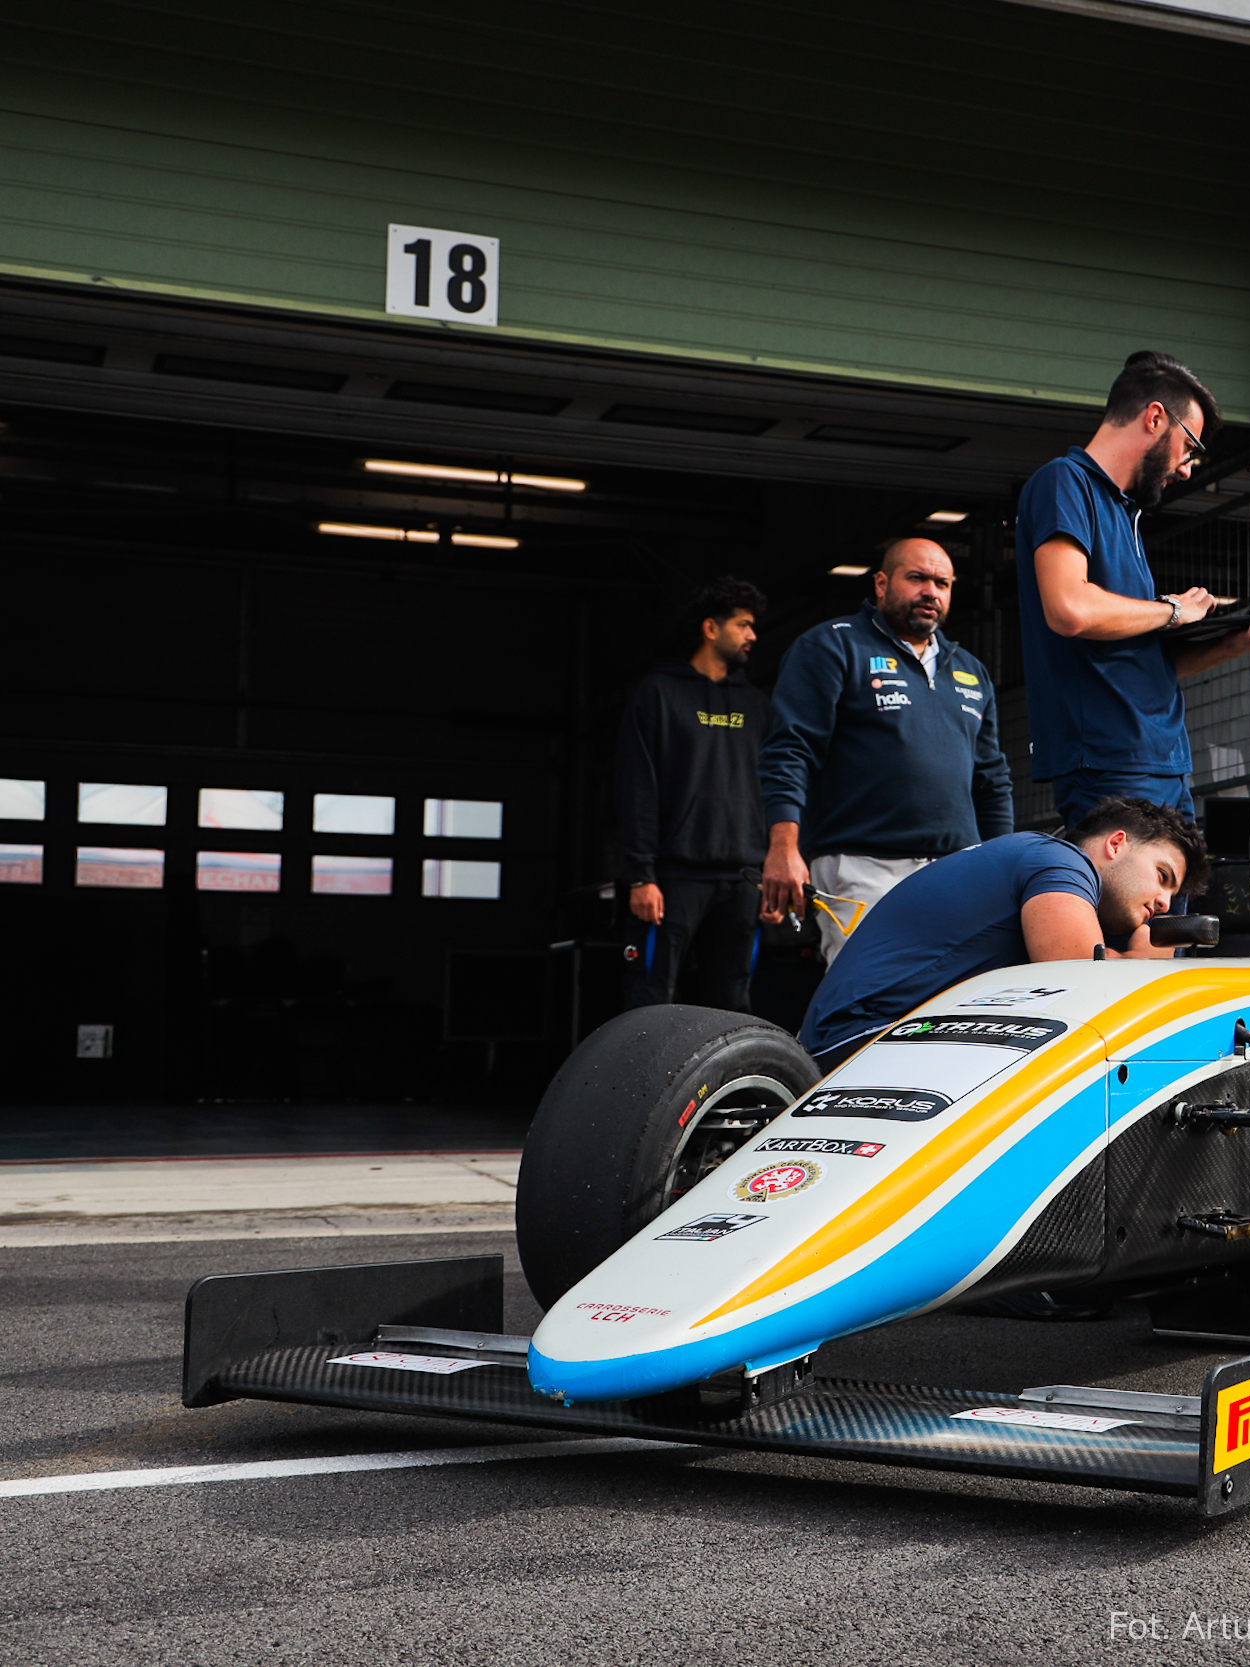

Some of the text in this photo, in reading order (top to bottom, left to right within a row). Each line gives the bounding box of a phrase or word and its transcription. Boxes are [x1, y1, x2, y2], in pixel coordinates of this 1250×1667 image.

[403, 237, 487, 314] 18
[935, 1021, 1054, 1037] TATUUS
[836, 1096, 937, 1111] KORUS
[576, 1302, 672, 1317] CARROSSERIE
[590, 1310, 637, 1323] LCH
